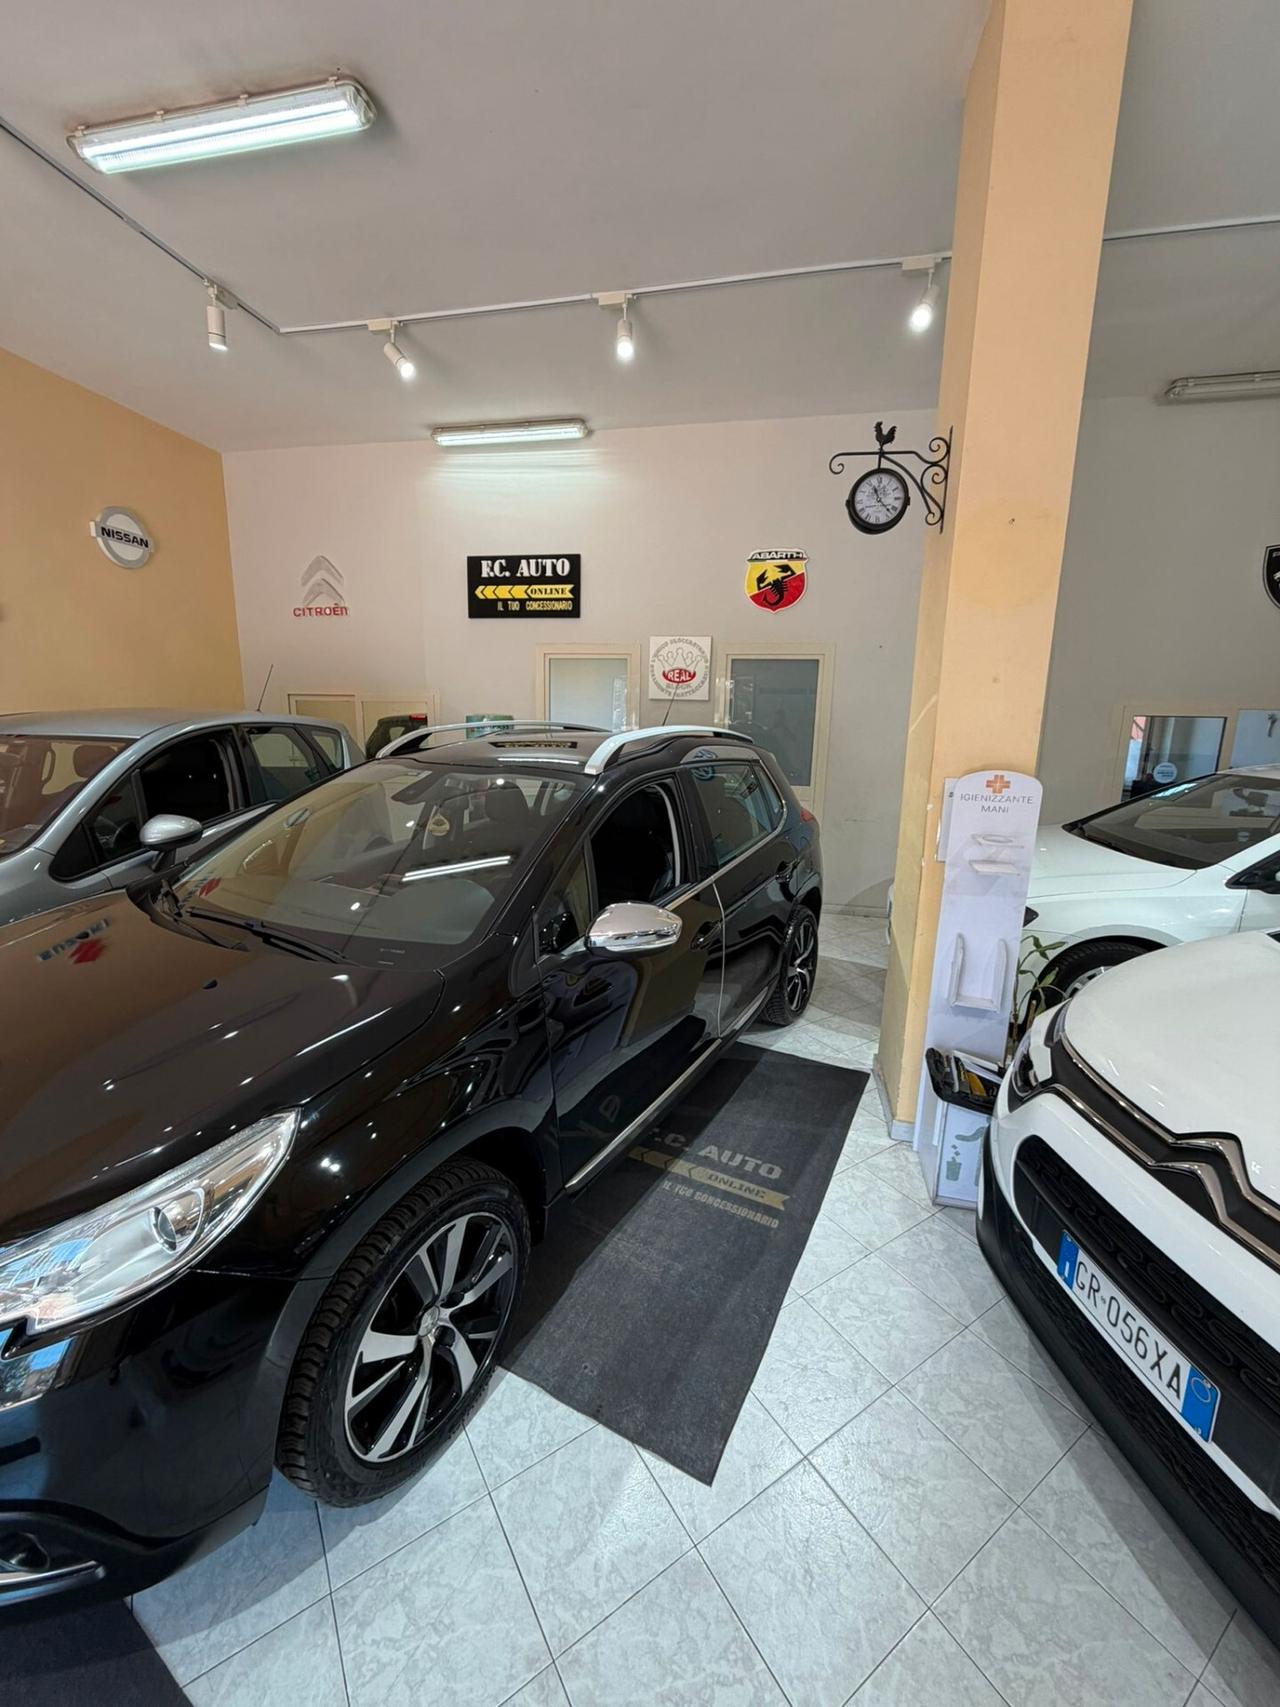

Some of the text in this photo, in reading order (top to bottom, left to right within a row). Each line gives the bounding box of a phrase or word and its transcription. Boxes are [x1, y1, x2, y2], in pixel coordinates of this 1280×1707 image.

[100, 526, 149, 548] NISSAN
[752, 551, 803, 559] ABARTH
[516, 558, 571, 577] AUTO
[530, 587, 568, 596] ONLINE
[508, 601, 520, 611] TUO
[525, 601, 573, 611] CONCESSIONARIO
[667, 669, 692, 682] REAL
[960, 793, 1034, 804] IGIENIZZANTE
[981, 805, 1009, 814] MANI
[697, 1144, 783, 1180] AUTO
[707, 1173, 768, 1200] ONLINE
[694, 1191, 780, 1229] CONCESSIONARIO
